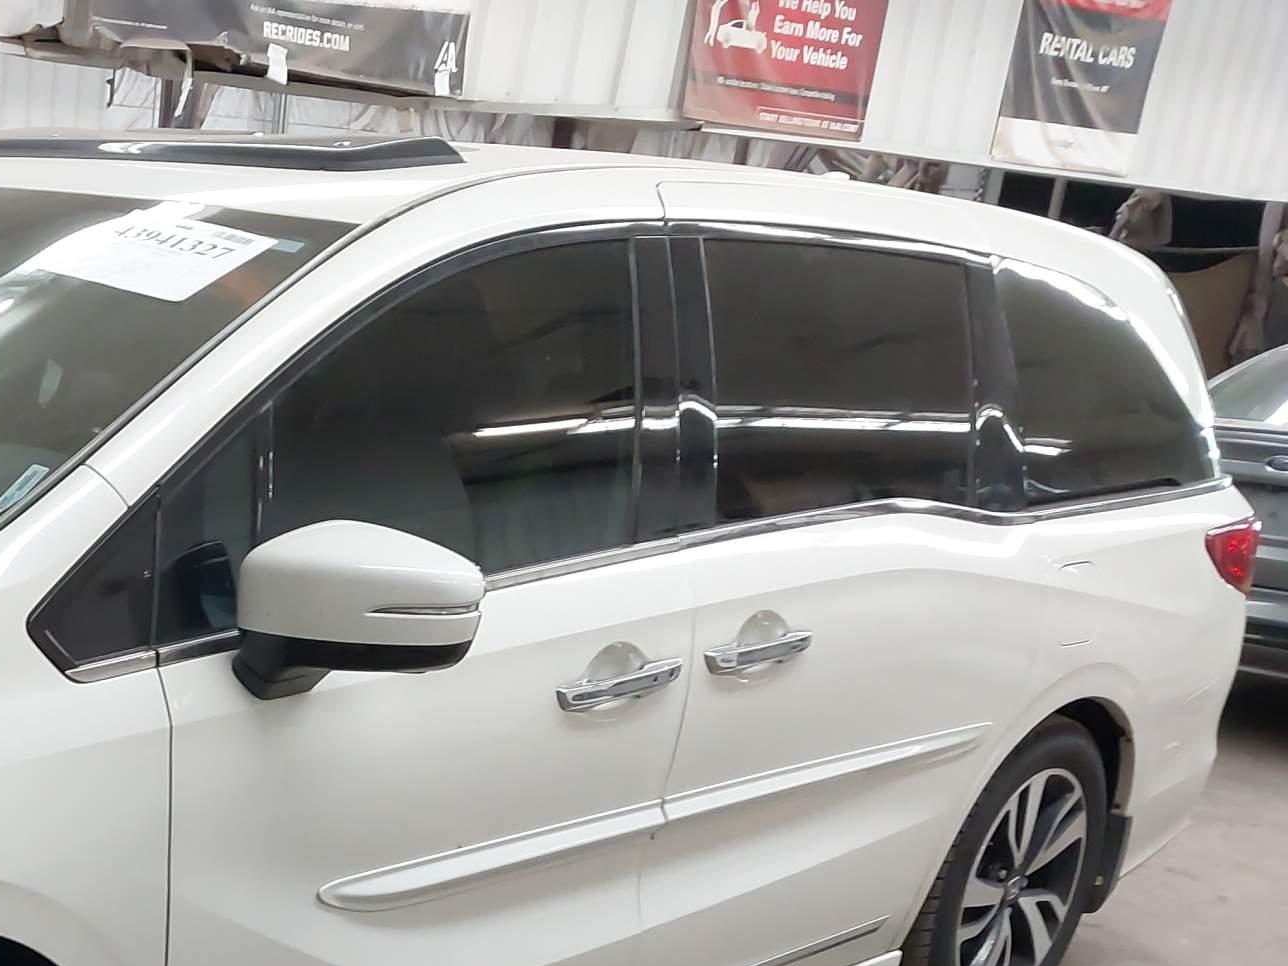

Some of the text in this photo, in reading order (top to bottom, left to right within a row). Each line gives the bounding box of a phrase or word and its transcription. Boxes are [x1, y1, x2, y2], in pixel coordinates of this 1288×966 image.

[801, 0, 831, 19] Help
[834, 0, 857, 21] You
[262, 21, 350, 51] RECRIDES.COM
[773, 15, 864, 48] Earn More For
[769, 40, 849, 70] Your Vehicle
[1039, 32, 1137, 69] RENTAL CARS
[112, 226, 236, 258] 43941327
